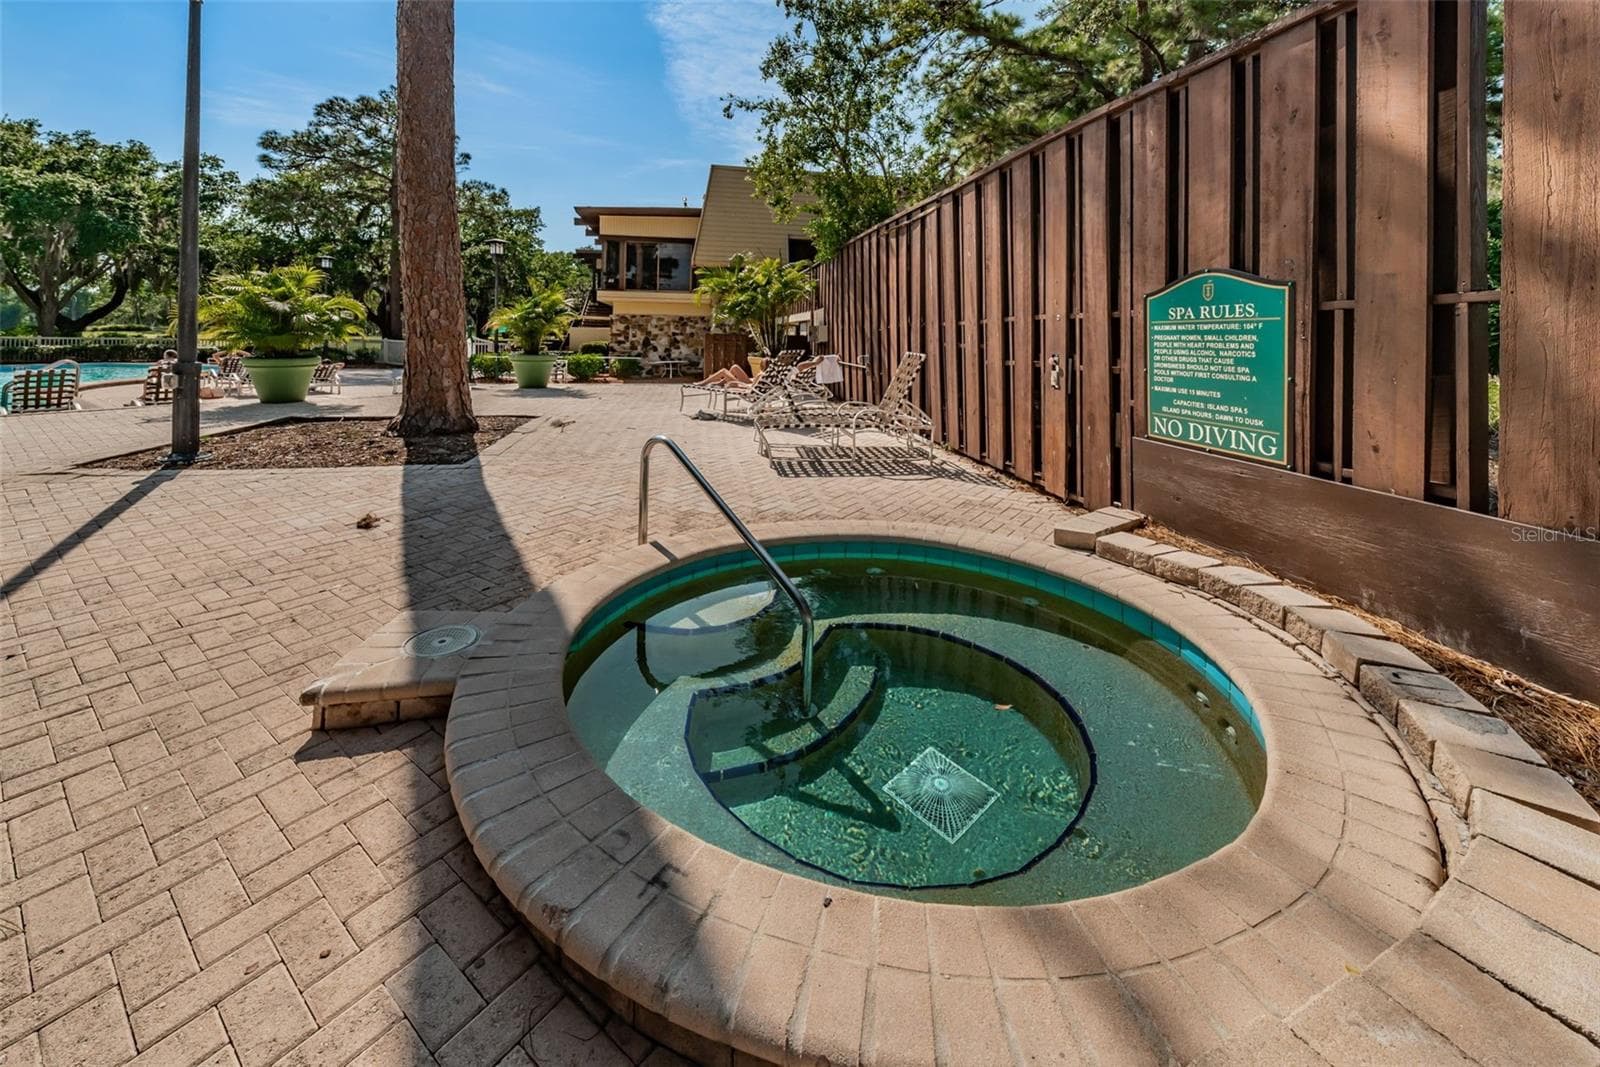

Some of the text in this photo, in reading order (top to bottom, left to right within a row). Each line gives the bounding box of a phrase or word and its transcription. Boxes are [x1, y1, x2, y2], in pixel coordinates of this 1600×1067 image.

[1168, 304, 1255, 320] SPA RULES
[1212, 373, 1250, 381] CONSULTING
[1196, 390, 1221, 398] MINUTES
[1207, 403, 1230, 412] ISLAND
[1215, 413, 1234, 422] DAWN
[1245, 418, 1264, 427] DUSK
[1154, 416, 1278, 456] NO DIVING
